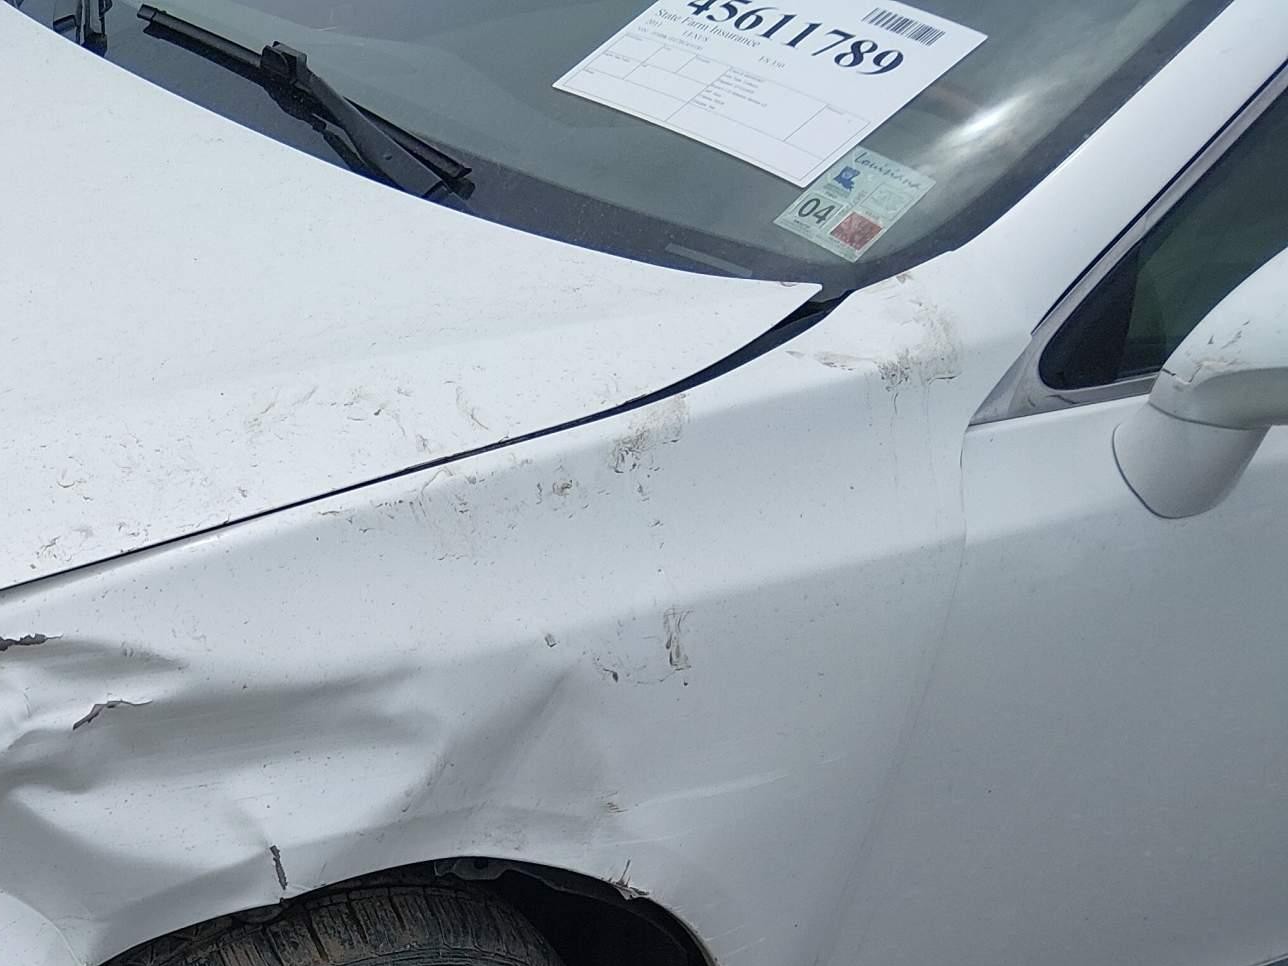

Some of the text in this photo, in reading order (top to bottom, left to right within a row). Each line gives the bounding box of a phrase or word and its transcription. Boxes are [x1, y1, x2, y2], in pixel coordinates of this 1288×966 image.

[656, 9, 681, 21] State
[682, 16, 709, 32] Farm
[710, 25, 761, 48] Insurance
[687, 0, 904, 75] 45611789
[854, 152, 921, 189] Louisiana
[798, 198, 835, 224] 04
